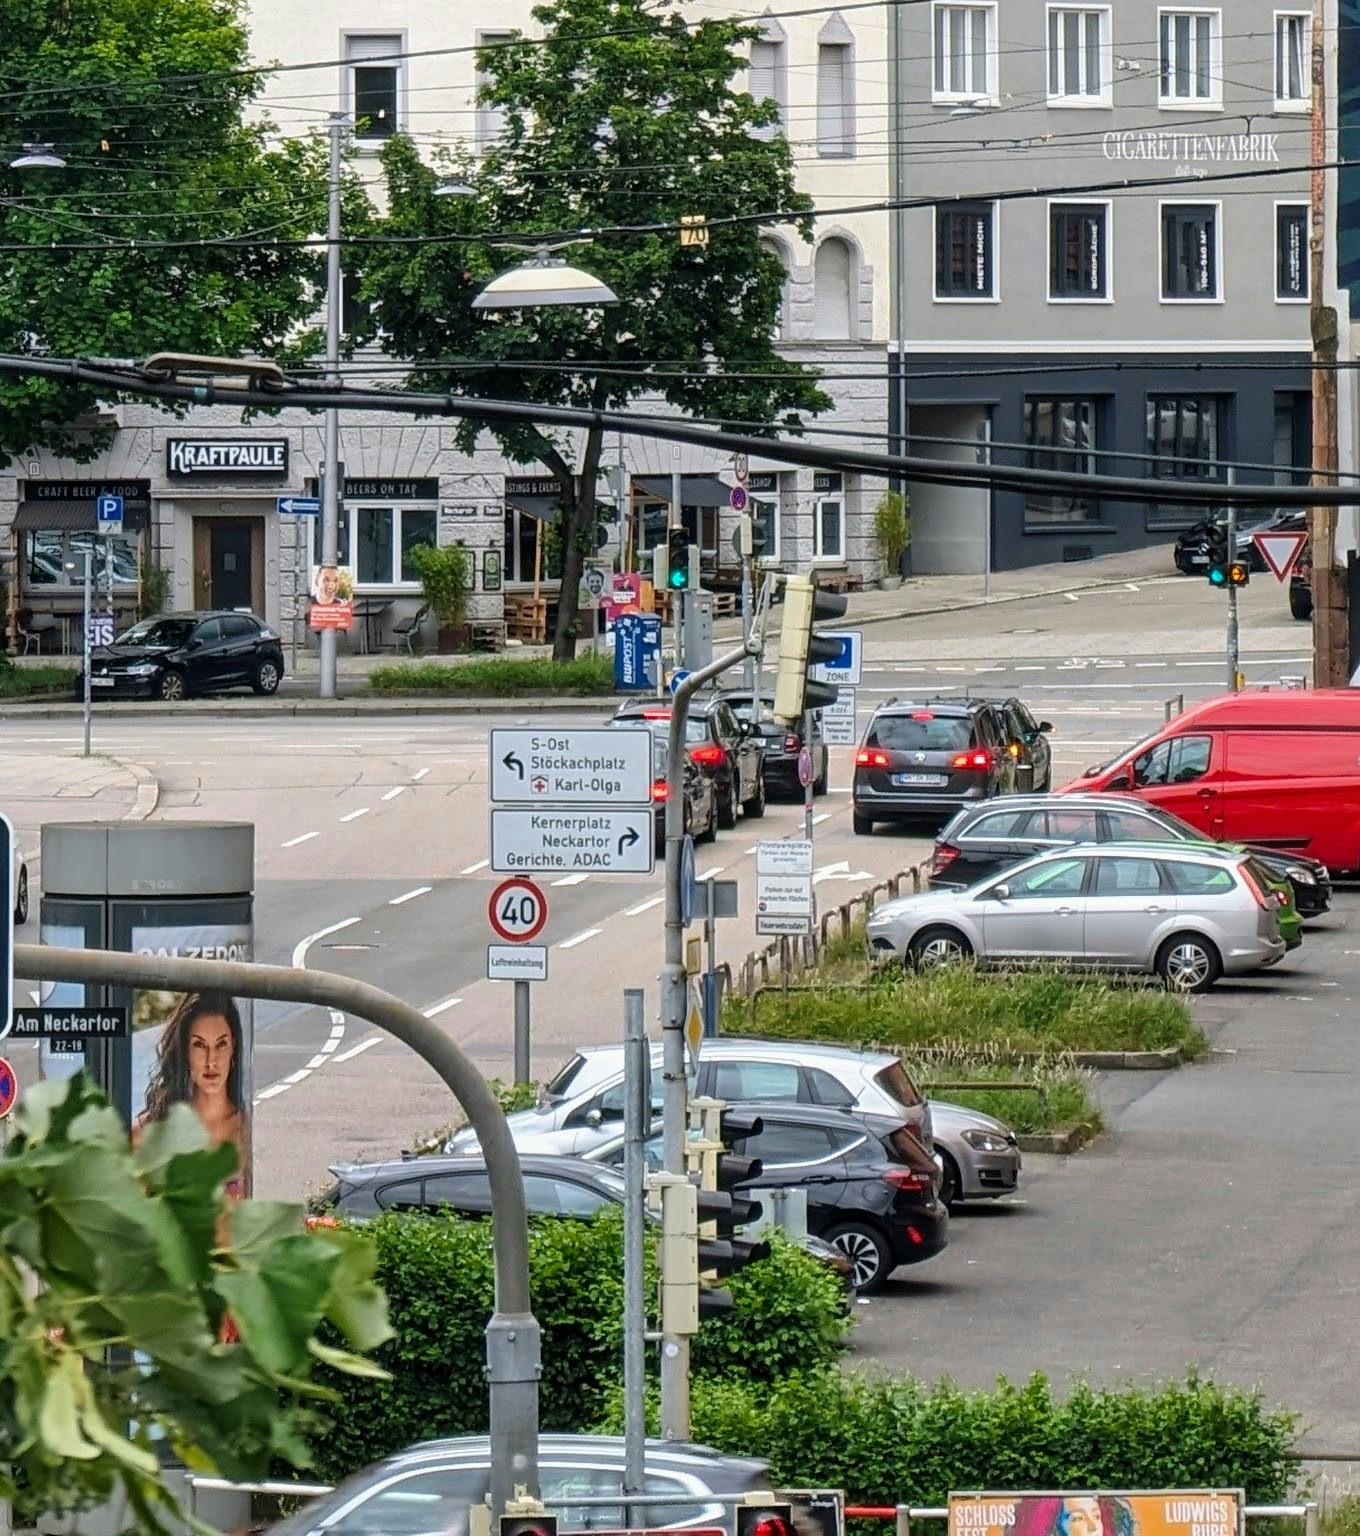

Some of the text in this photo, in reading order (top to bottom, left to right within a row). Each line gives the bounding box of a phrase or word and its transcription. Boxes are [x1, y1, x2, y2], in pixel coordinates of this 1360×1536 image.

[1102, 132, 1280, 162] CIGARETTENFABRIK
[171, 442, 285, 473] KRAFTPAULE
[37, 486, 68, 497] CRAFT
[72, 486, 97, 497] BEER
[346, 484, 418, 496] BEERS ON TAP
[103, 499, 117, 518] P
[825, 672, 850, 682] ZONE
[531, 738, 570, 751] S-Ost
[531, 756, 626, 772] Stöckachplatz
[555, 778, 621, 794] Karl-Olga
[531, 816, 612, 832] Kernerplatz
[542, 834, 611, 848] Neckartor
[573, 853, 612, 866] ADAC
[501, 896, 536, 925] 40
[15, 1013, 121, 1032] Am Neckartor
[956, 1503, 1016, 1526] SCHLOSS
[1165, 1502, 1228, 1524] LUDWIGS
